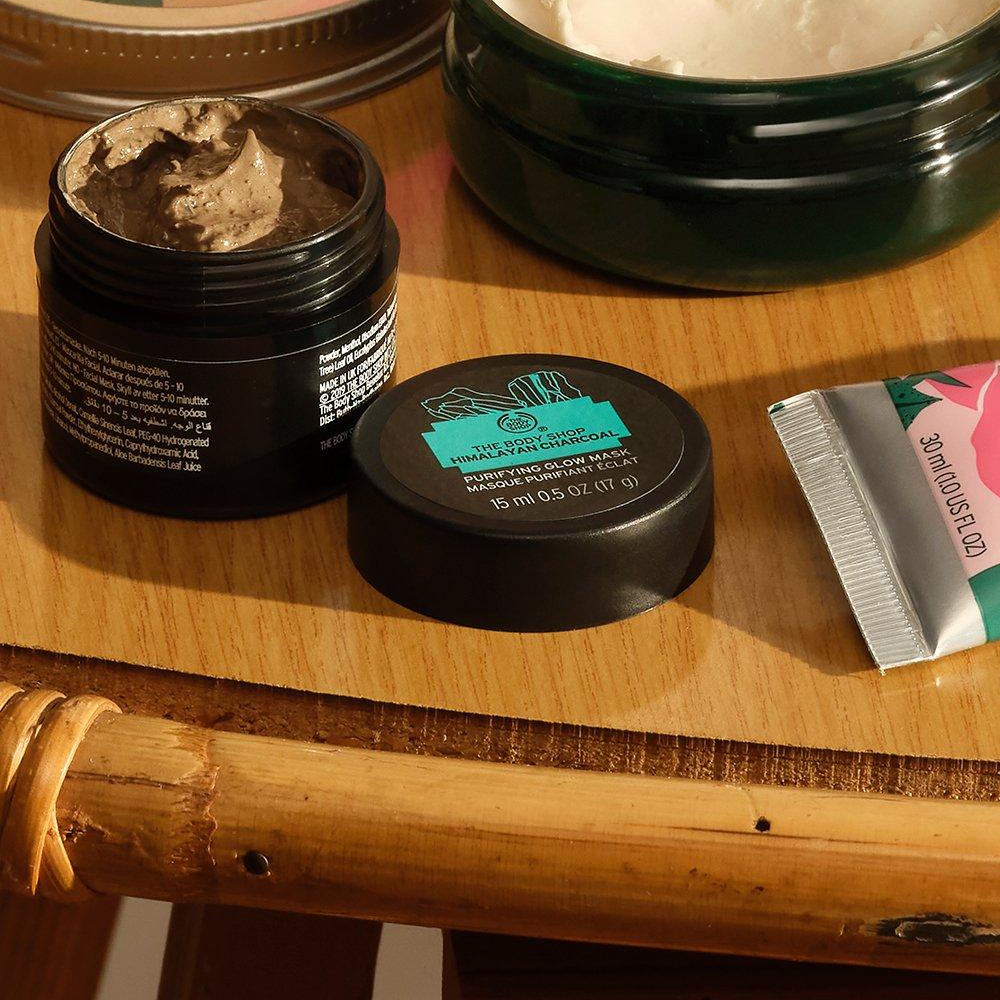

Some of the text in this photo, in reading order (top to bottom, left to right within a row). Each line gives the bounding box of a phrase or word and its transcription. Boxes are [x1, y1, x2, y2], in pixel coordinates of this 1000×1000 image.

[319, 376, 340, 394] MADE
[176, 395, 210, 406] minutter.
[319, 404, 333, 415] The
[333, 394, 351, 410] Body
[161, 434, 210, 448] Hydrogenated
[450, 430, 620, 465] HIMALAYAN CHARCOAL
[472, 427, 587, 452] THE BODY SHOP
[183, 461, 202, 472] Juice
[463, 448, 632, 484] PURIFYING GLOW MASK
[466, 456, 639, 493] MASQUE PURIFIANT ÉCLAT
[489, 474, 640, 511] 15 ml 0.5 OZ (17 g)
[919, 432, 988, 558] 30 ml (1.0 US FL OZ)
